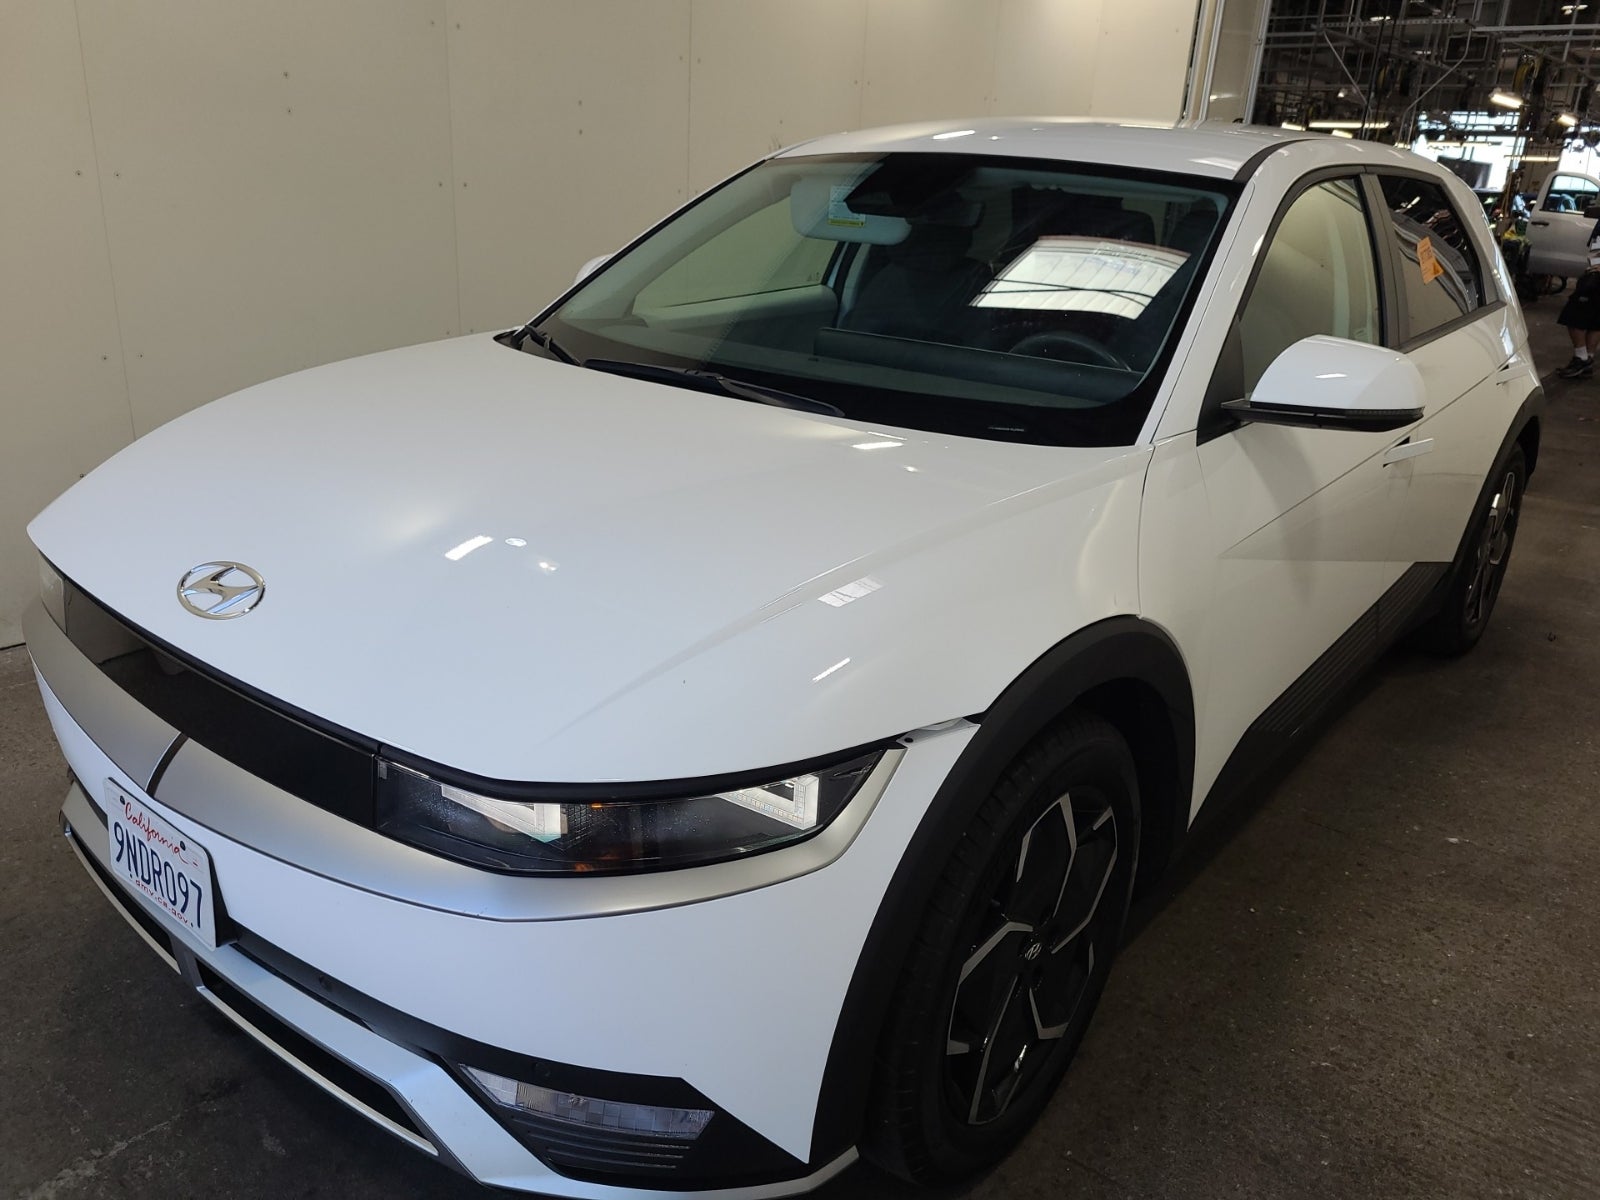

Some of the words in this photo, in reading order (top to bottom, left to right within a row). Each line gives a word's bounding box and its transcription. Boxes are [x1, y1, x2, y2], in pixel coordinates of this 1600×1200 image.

[124, 802, 187, 863] California
[114, 821, 203, 928] 9NDR097
[135, 879, 188, 924] dmv.ca.gov
